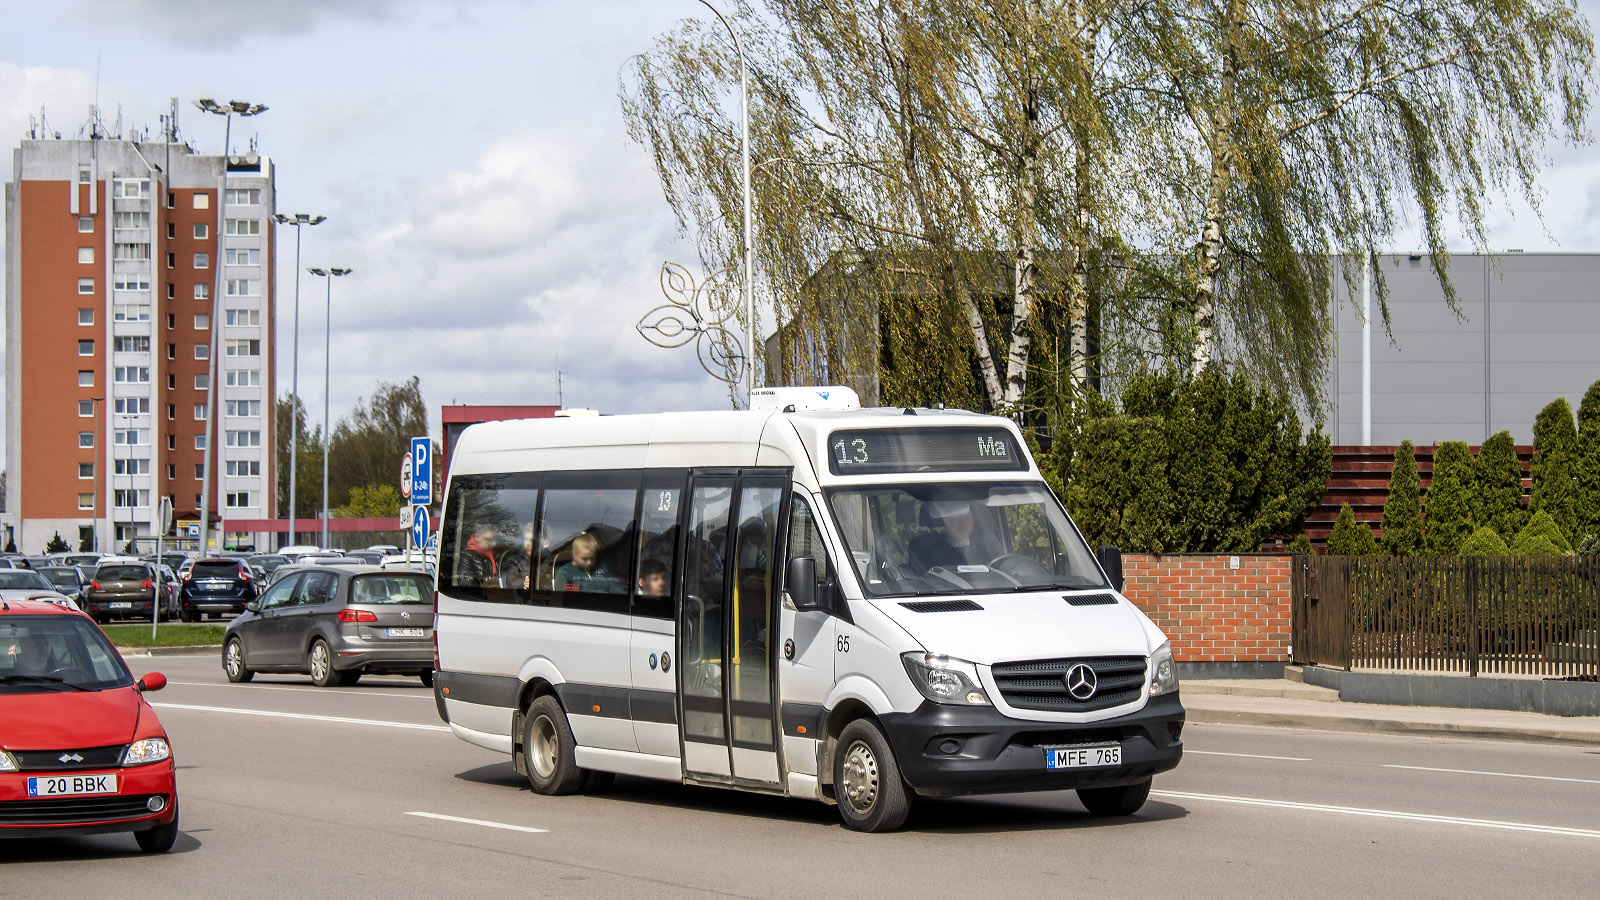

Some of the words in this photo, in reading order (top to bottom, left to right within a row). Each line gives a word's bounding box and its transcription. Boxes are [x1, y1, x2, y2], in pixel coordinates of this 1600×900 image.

[416, 443, 427, 476] P
[834, 438, 869, 464] 13
[977, 436, 1006, 456] Ma
[658, 491, 671, 511] 13
[837, 634, 850, 653] 65
[1057, 750, 1088, 767] MFE
[1096, 748, 1119, 765] 765
[47, 778, 67, 794] 20
[73, 776, 108, 792] BBK
